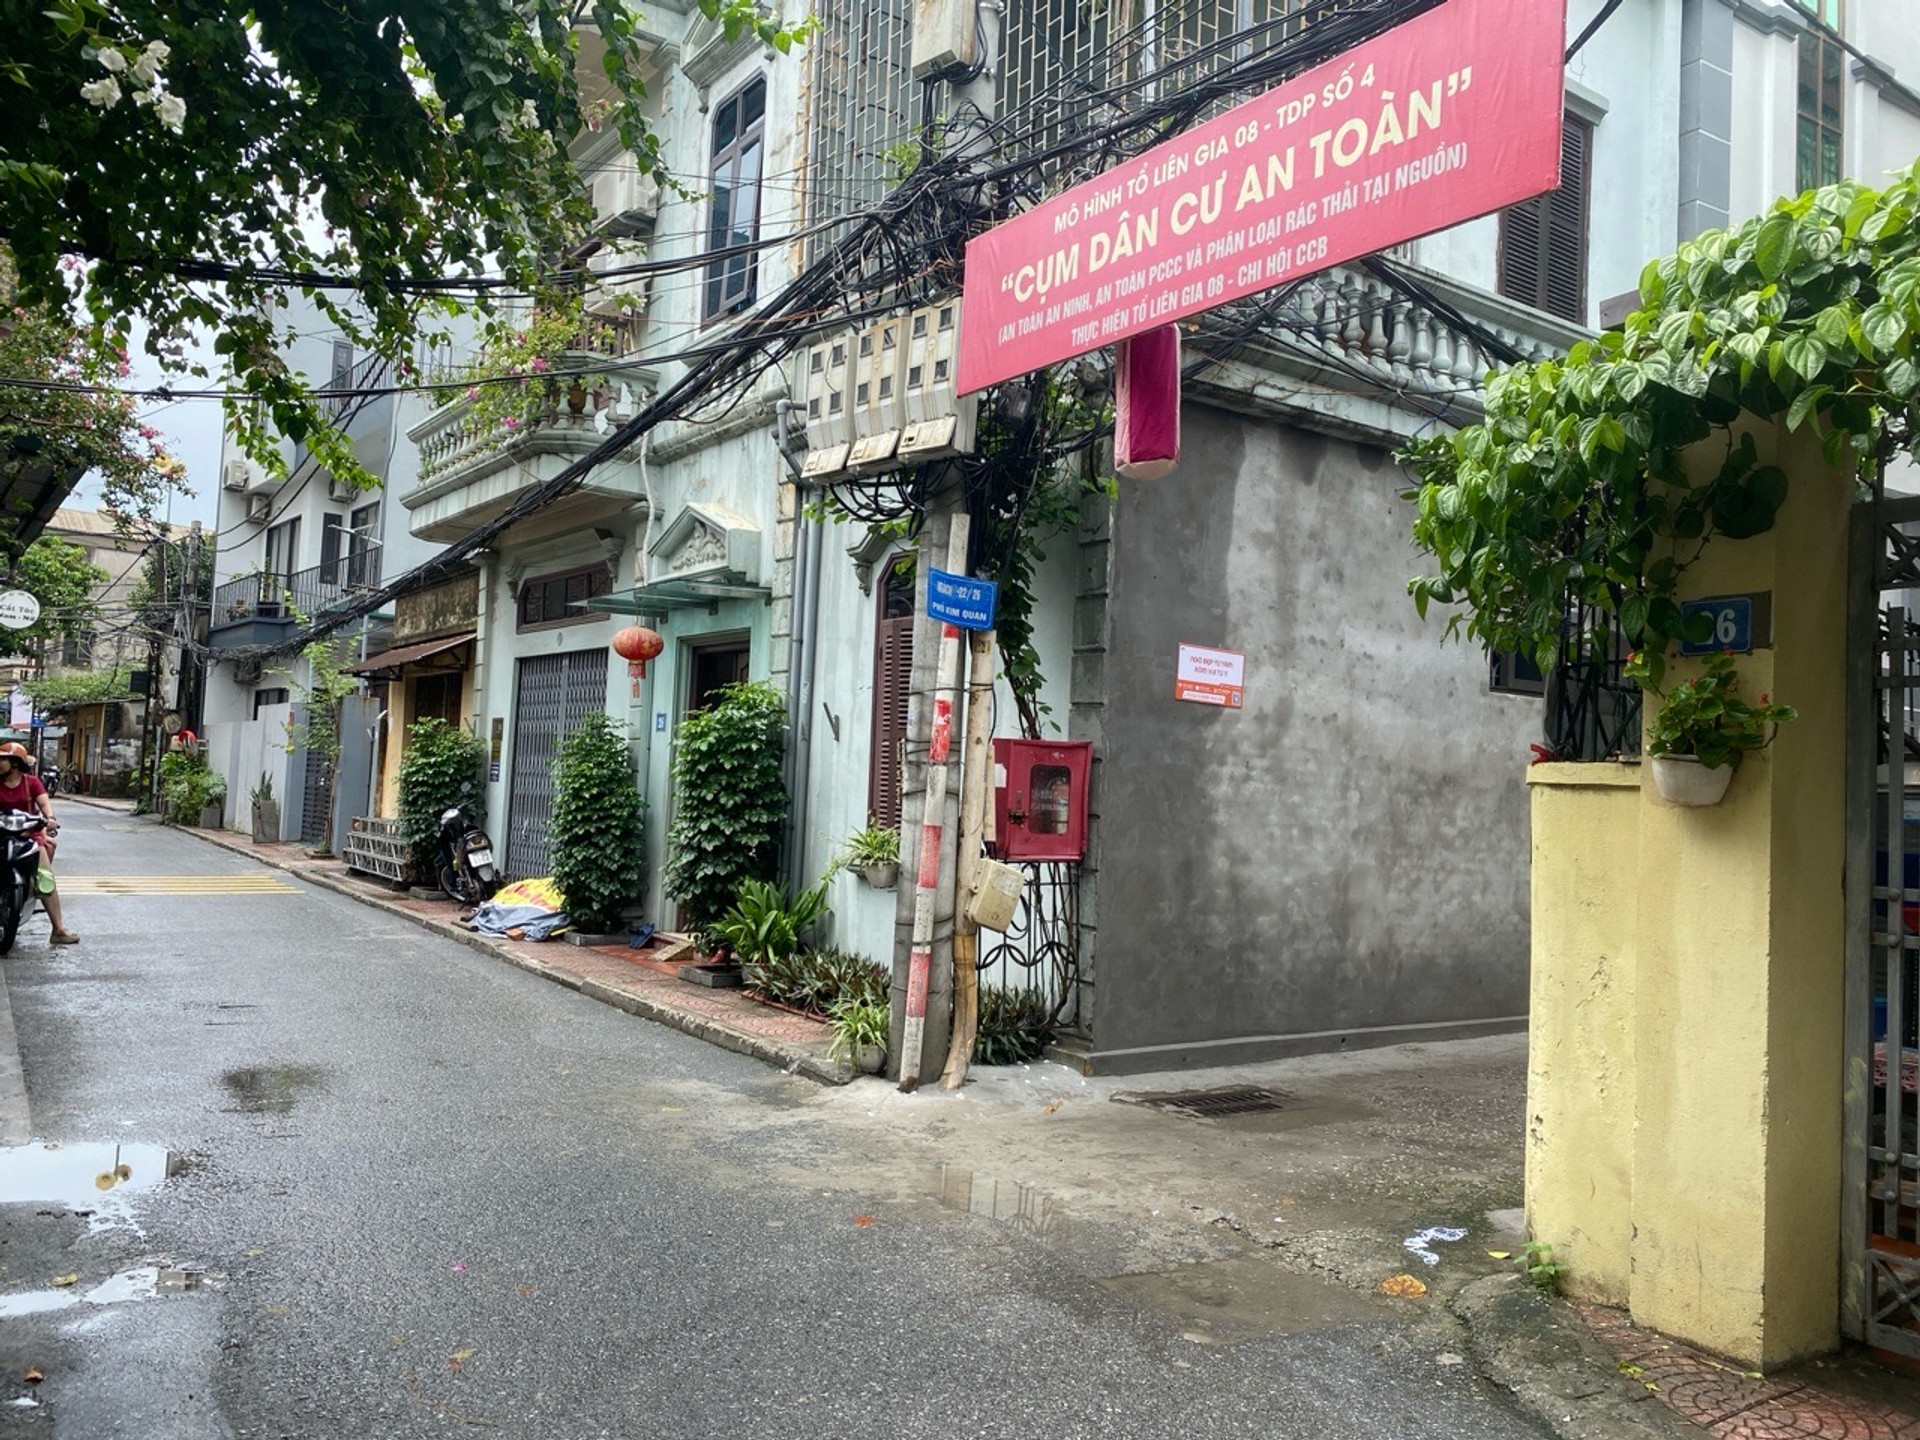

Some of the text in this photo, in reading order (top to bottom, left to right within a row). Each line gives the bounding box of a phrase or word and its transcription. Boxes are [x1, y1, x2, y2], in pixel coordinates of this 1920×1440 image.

[1054, 62, 1376, 235] MÔ HÌNH TỔ LIÊN GIA 08 - TDP SỐ 4
[1088, 207, 1160, 274] DÂN
[1169, 170, 1228, 236] CƯ
[1234, 147, 1296, 213] AN
[997, 141, 1468, 347] (AN TOÀN AN NINH, AN TOÀN PCCC VÀ PHÂN LOẠI RÁC THẢI TẠI NGUỒN)
[1071, 322, 1099, 348] THỰC
[1101, 310, 1129, 336] HIỆN
[1149, 289, 1178, 320] LIÊN
[1181, 281, 1204, 308] GIA
[1206, 274, 1224, 299] 08
[1237, 261, 1263, 288] CHI
[1265, 246, 1292, 278] HỘI
[1295, 235, 1329, 267] CCB
[961, 609, 987, 622] QUAN
